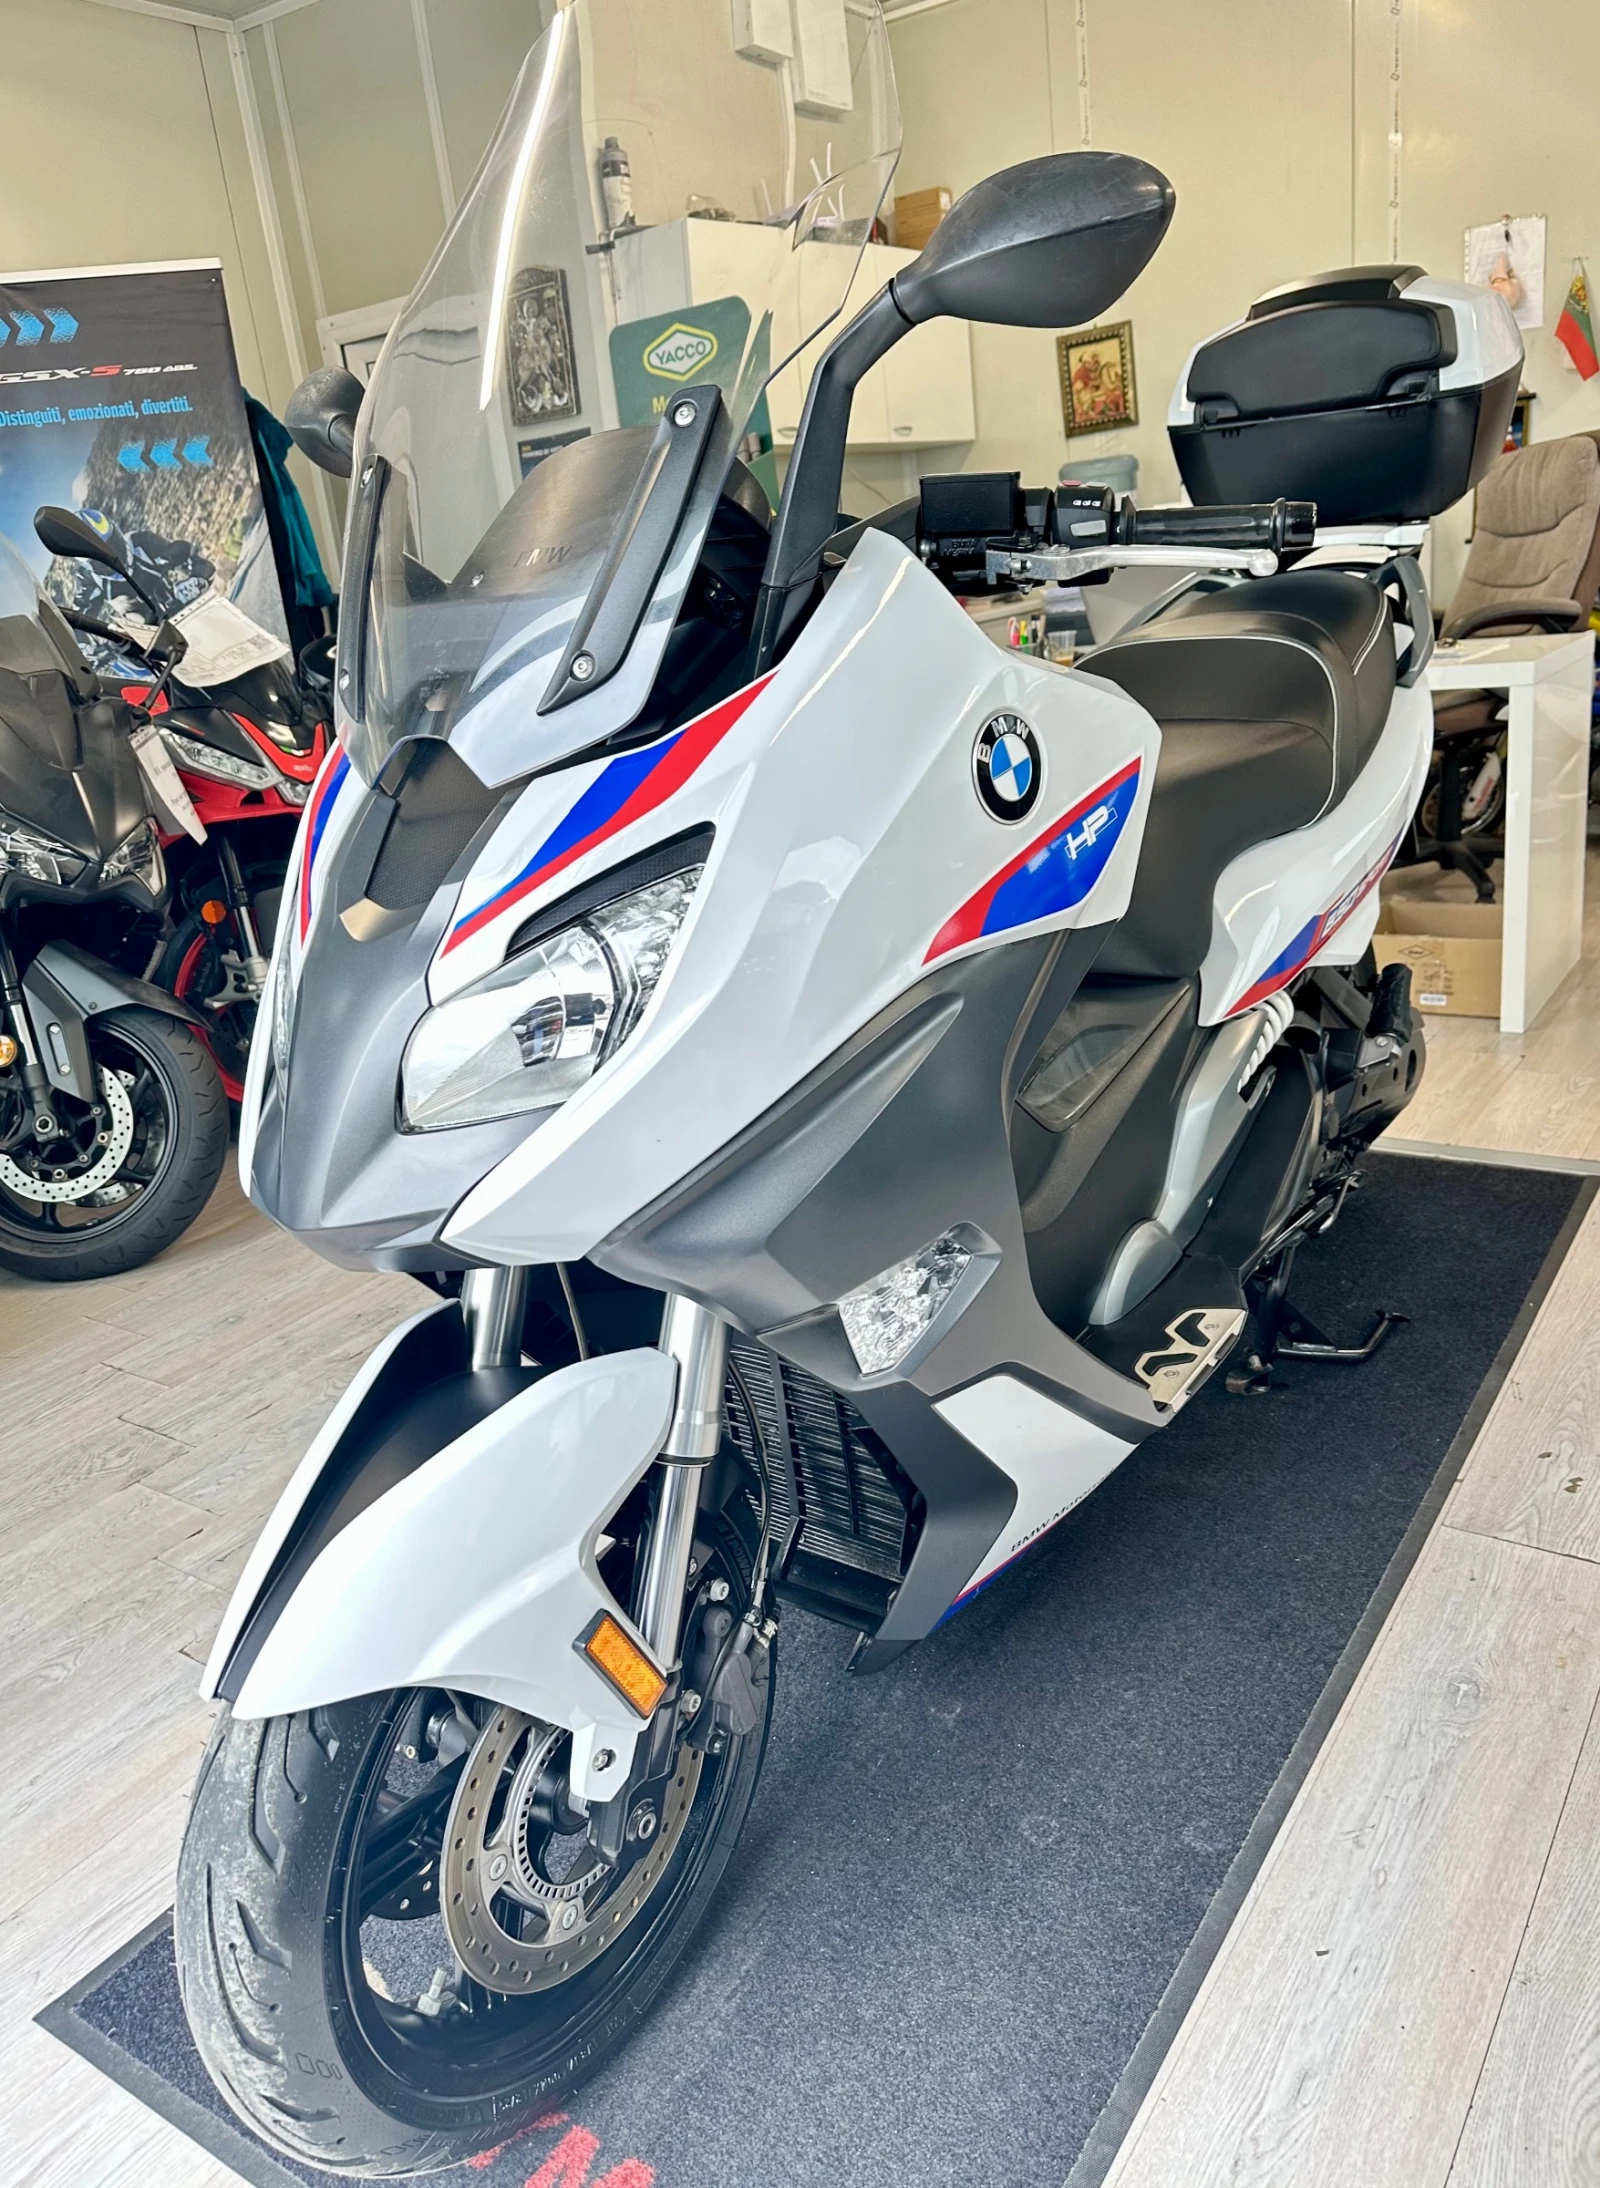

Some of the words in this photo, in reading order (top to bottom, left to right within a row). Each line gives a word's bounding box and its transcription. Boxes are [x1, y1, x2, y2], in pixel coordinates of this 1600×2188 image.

[656, 341, 706, 365] YACCO
[0, 364, 122, 384] GSX-S
[123, 365, 161, 376] 750
[0, 407, 66, 428] Distinguiti,
[68, 400, 139, 419] emozionati,
[141, 396, 193, 415] divertiti.
[977, 716, 1030, 763] BMW
[1066, 805, 1109, 860] HP
[1011, 1518, 1050, 1552] BMW
